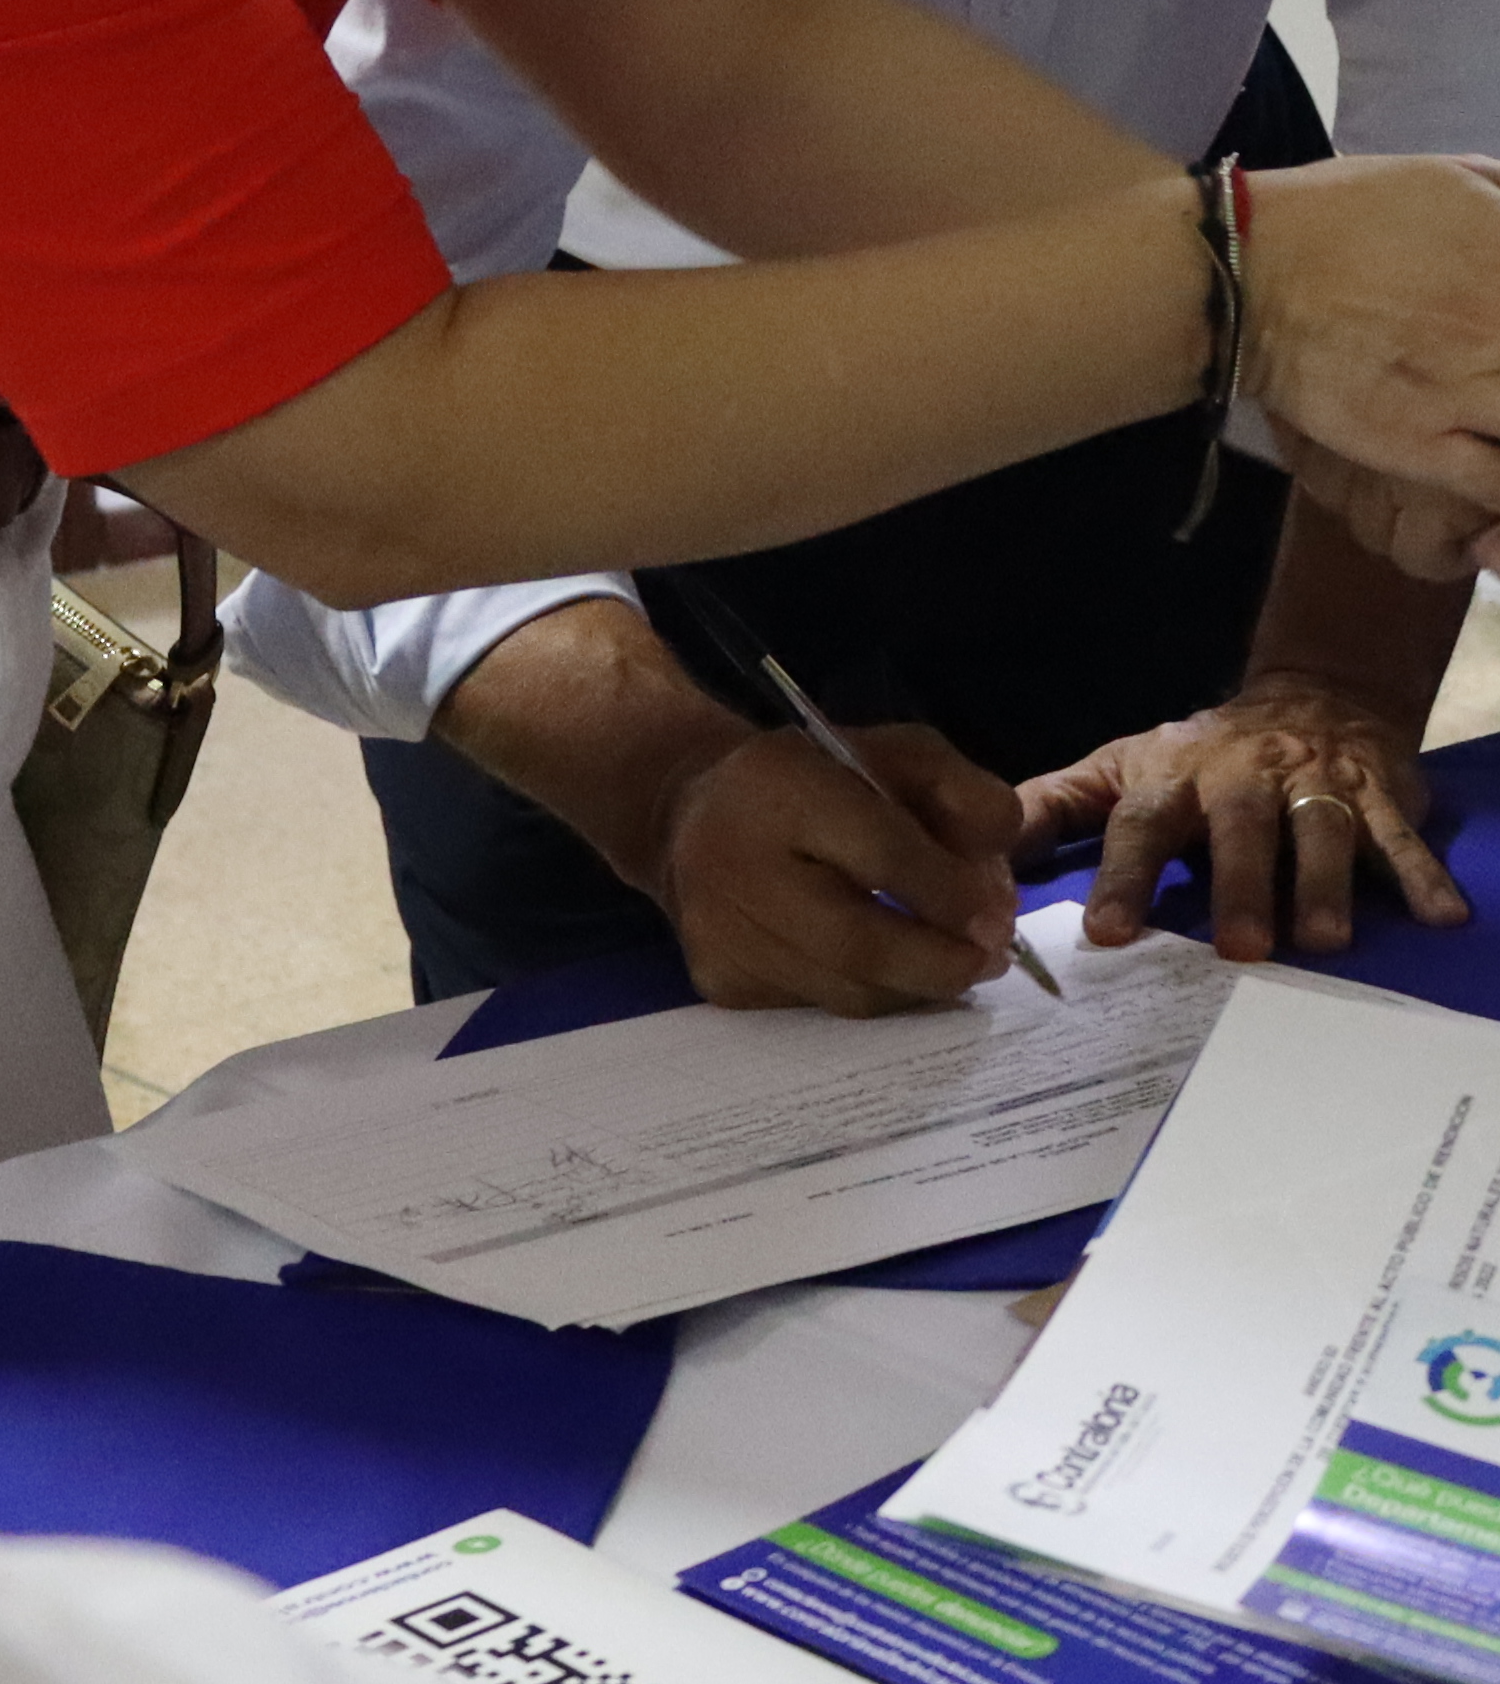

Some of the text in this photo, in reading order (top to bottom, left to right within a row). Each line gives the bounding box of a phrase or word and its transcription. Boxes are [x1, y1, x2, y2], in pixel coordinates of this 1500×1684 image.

[1421, 1168, 1442, 1191] DE
[1375, 1251, 1407, 1292] ACTO
[1368, 1291, 1388, 1312] AL
[1341, 1312, 1378, 1364] FRENTE
